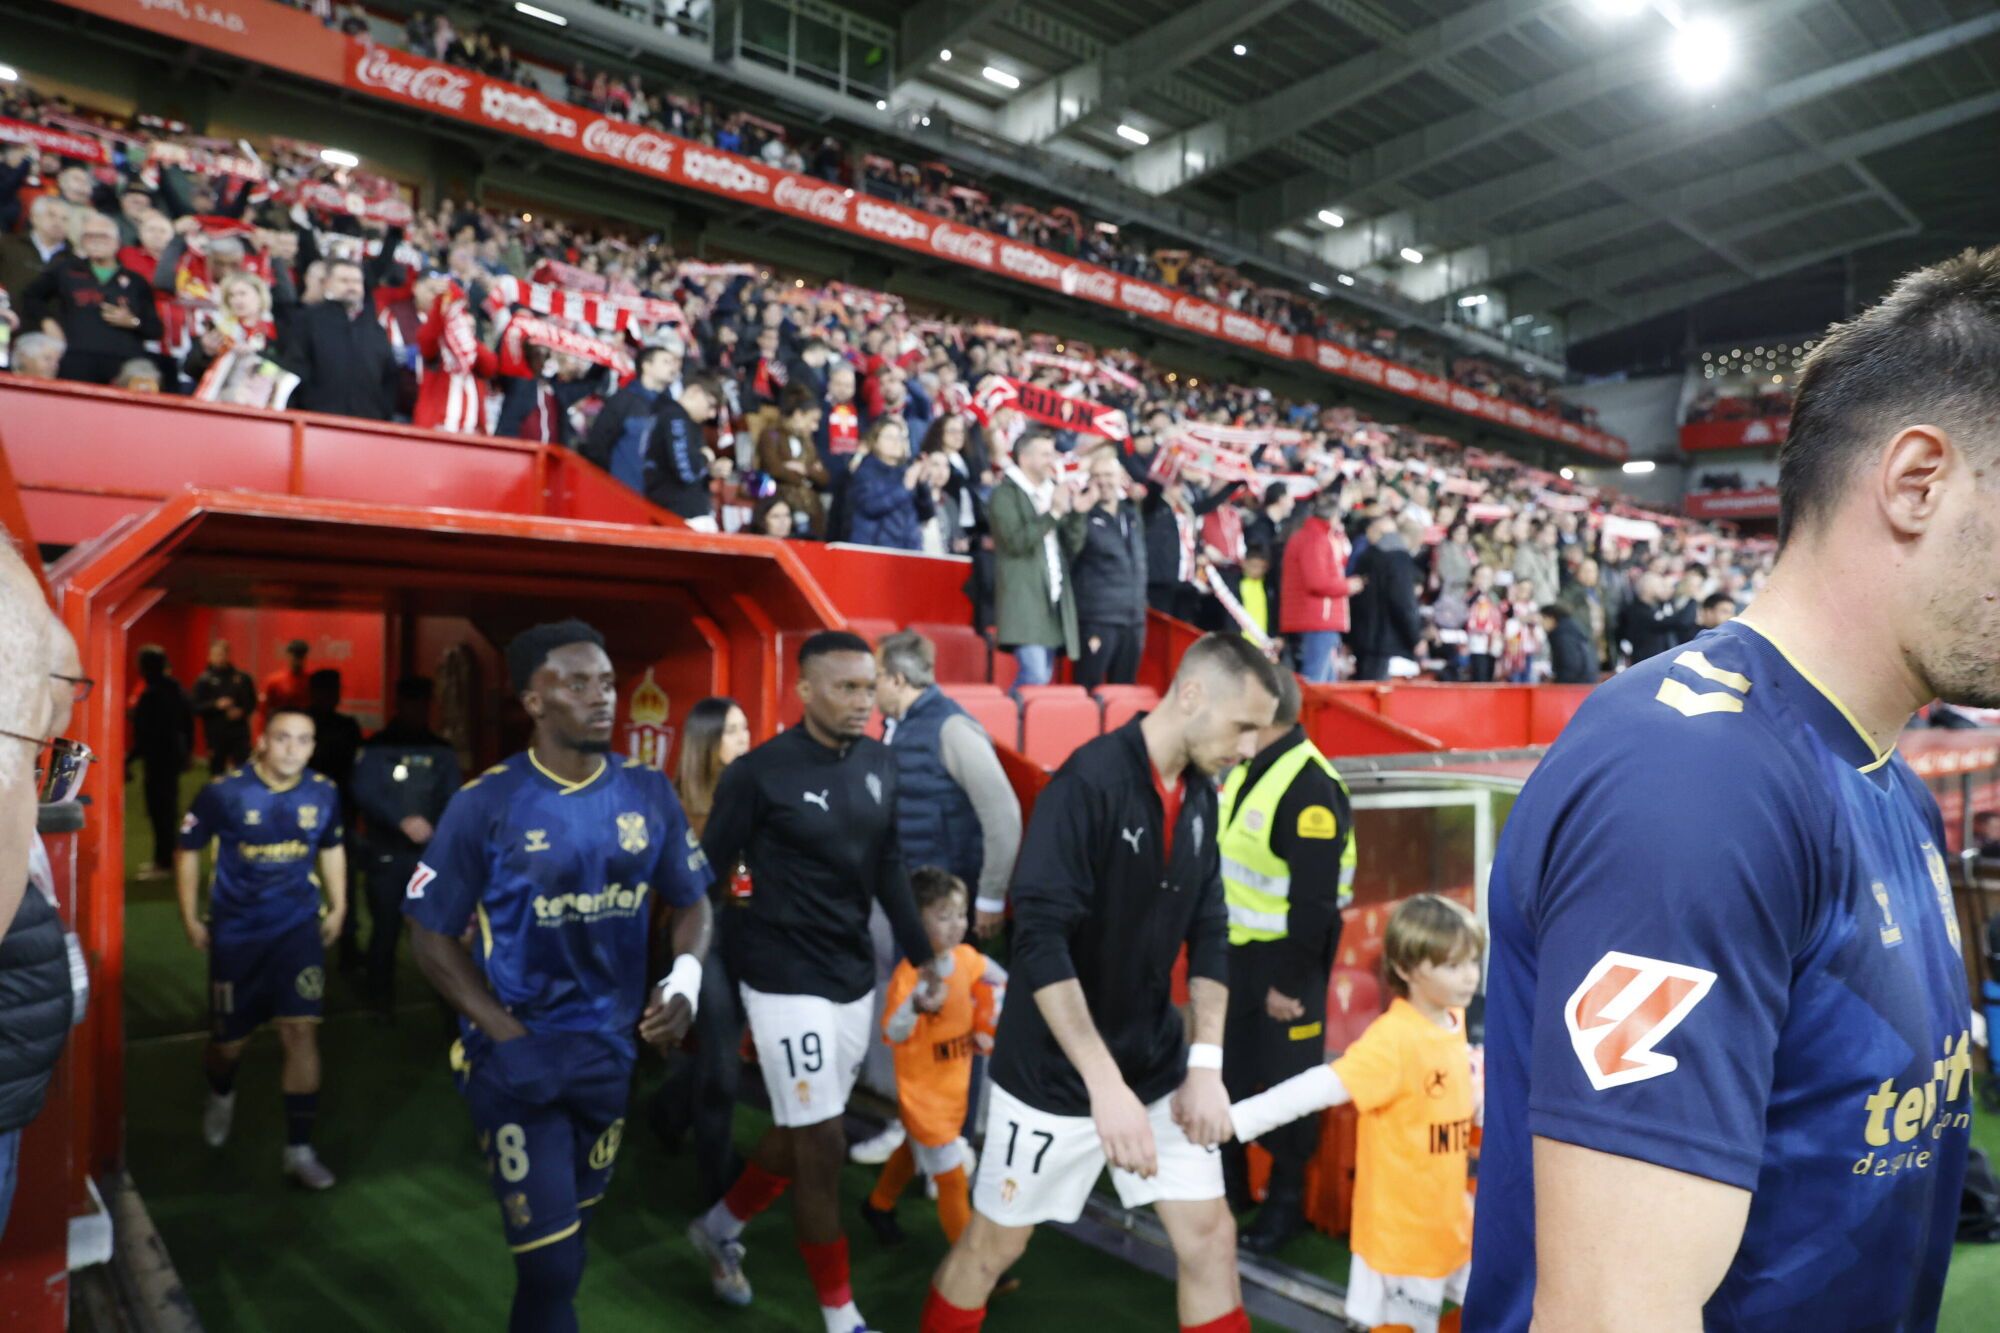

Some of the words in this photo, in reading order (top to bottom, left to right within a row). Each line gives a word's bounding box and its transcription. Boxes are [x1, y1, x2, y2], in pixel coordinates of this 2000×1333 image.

[356, 50, 471, 109] Coca-Cola
[583, 120, 676, 173] Coca-Cola
[774, 176, 851, 224] Coca-Cola
[780, 1032, 823, 1078] 19
[496, 1123, 530, 1183] 8
[1008, 1120, 1054, 1174] 17
